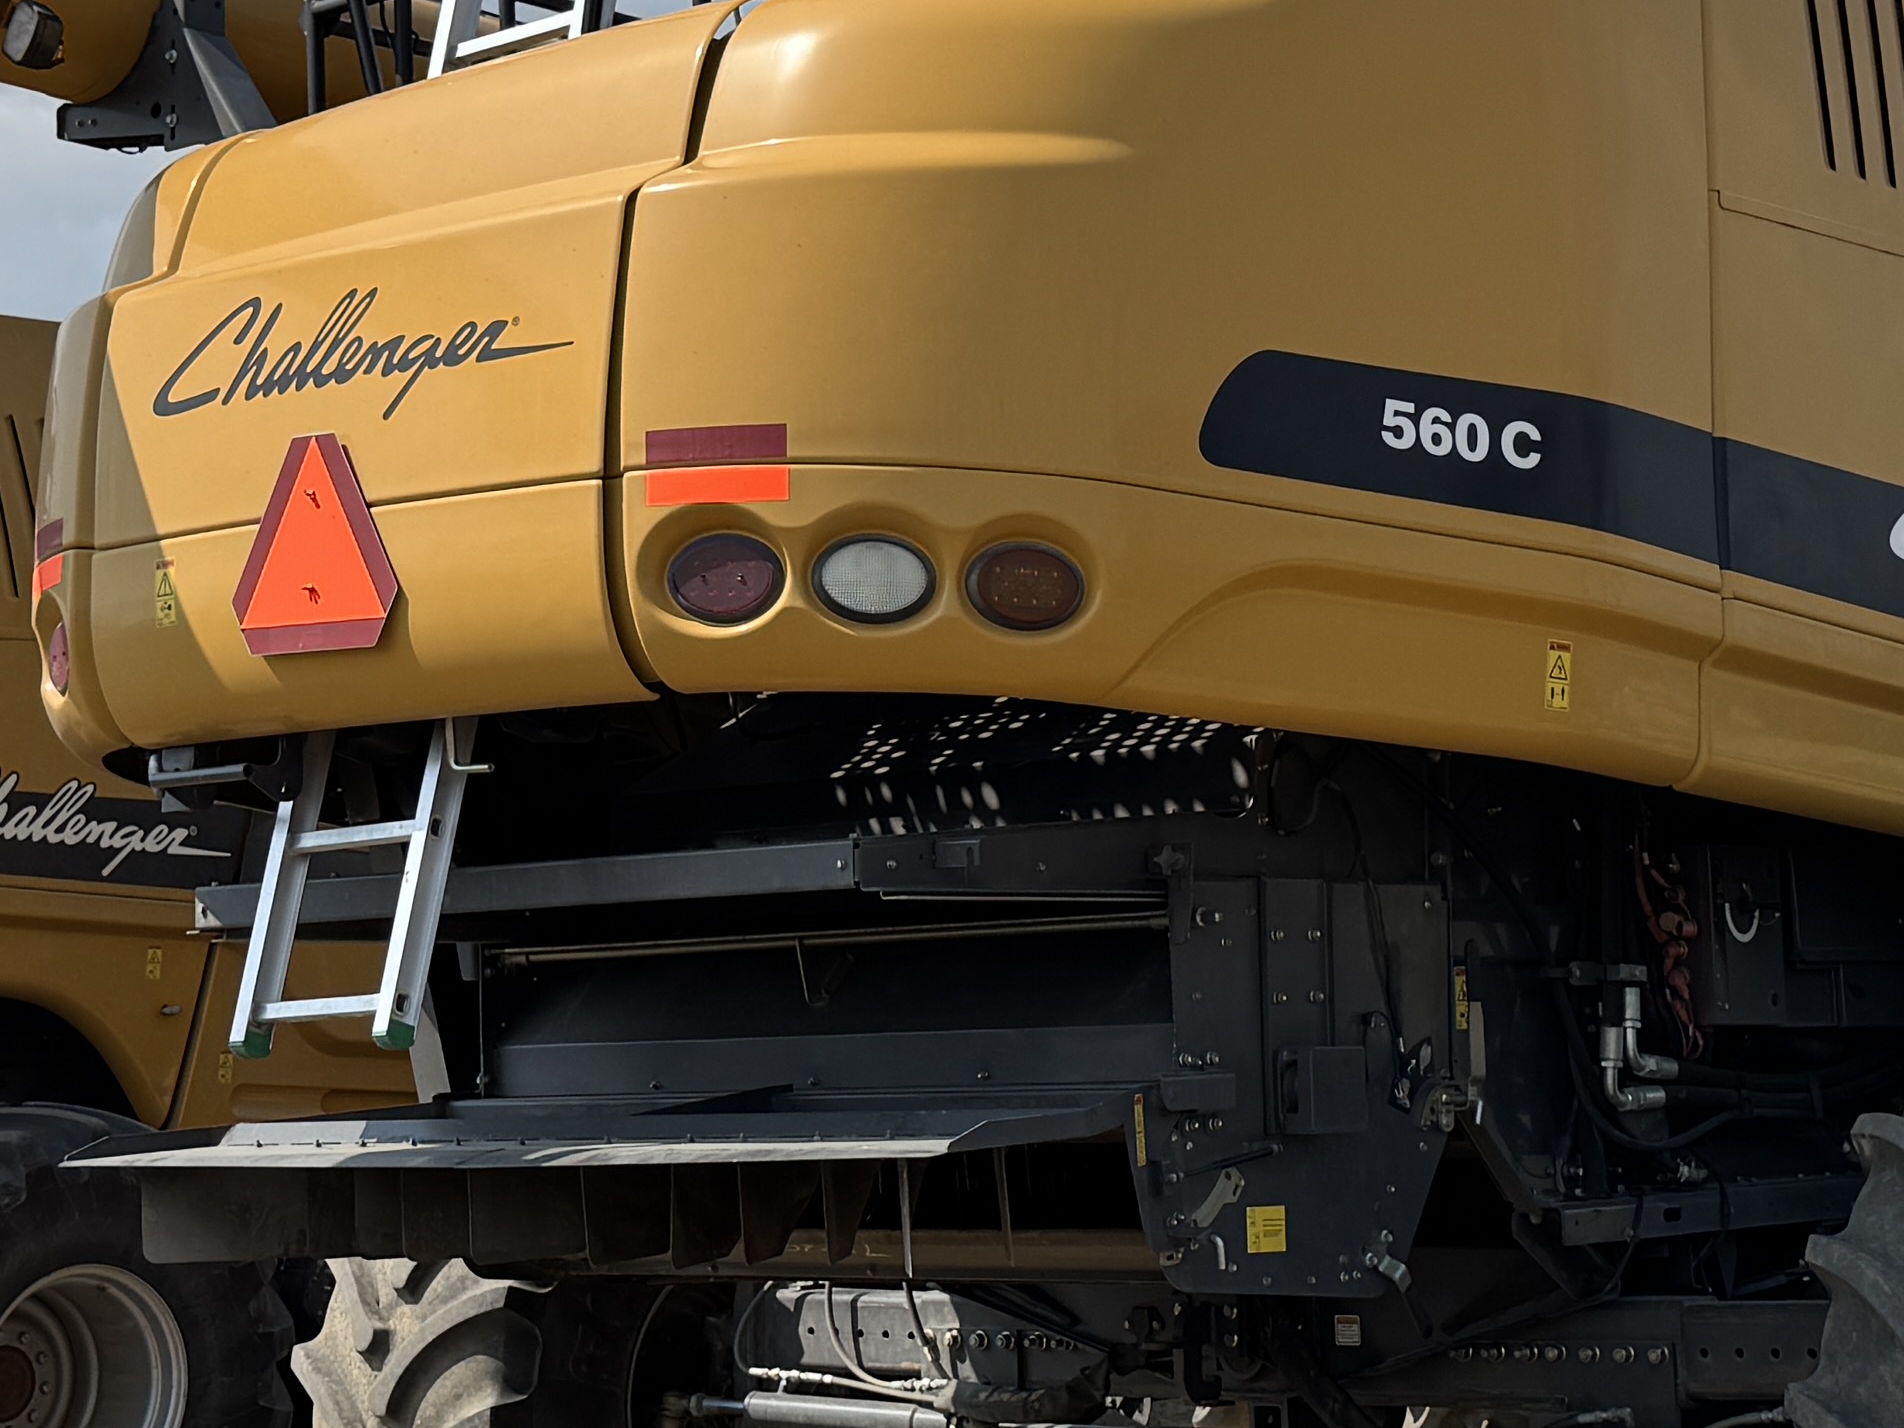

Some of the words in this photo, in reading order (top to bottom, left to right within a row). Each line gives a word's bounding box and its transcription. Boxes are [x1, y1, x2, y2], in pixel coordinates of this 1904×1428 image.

[152, 286, 575, 421] Challenger
[1380, 397, 1491, 463] 560
[1500, 420, 1543, 470] C
